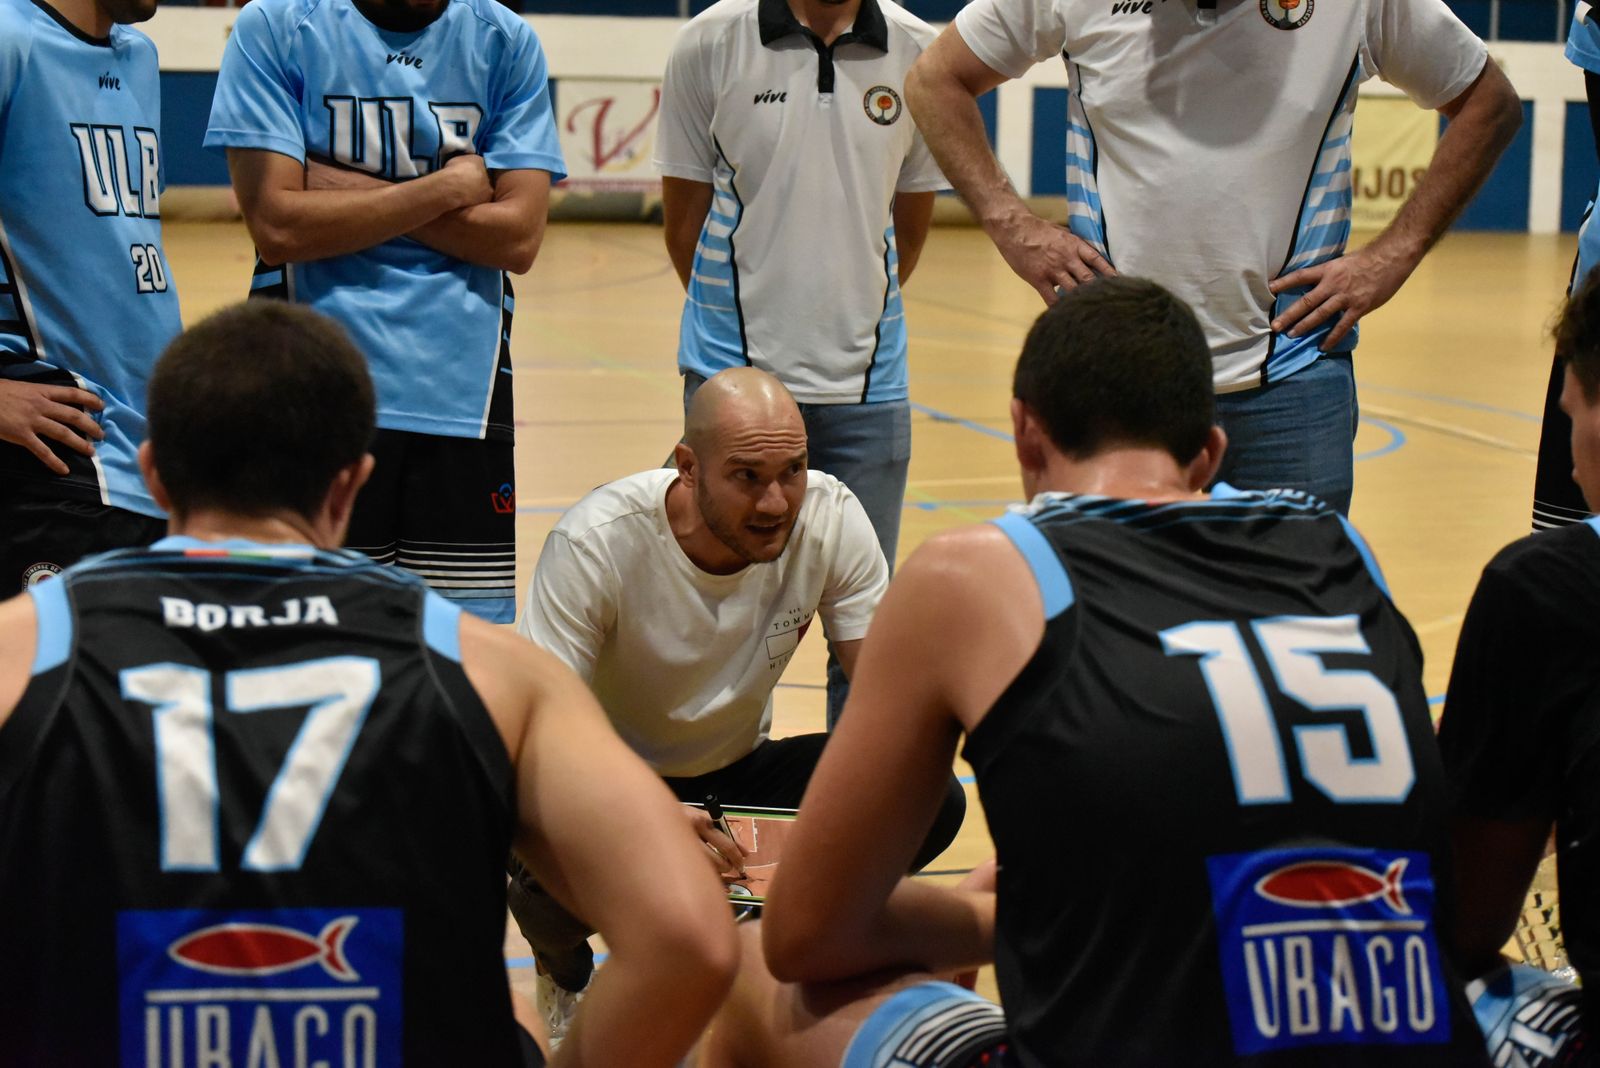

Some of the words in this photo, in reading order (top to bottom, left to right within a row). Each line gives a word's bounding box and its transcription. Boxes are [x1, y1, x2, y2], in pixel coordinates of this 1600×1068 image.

[70, 123, 160, 219] ULB
[130, 244, 168, 294] 20
[160, 596, 339, 632] BORJA
[773, 612, 812, 630] TOMM
[1158, 614, 1416, 805] 15
[119, 655, 382, 873] 17
[1243, 933, 1436, 1038] UBAGO
